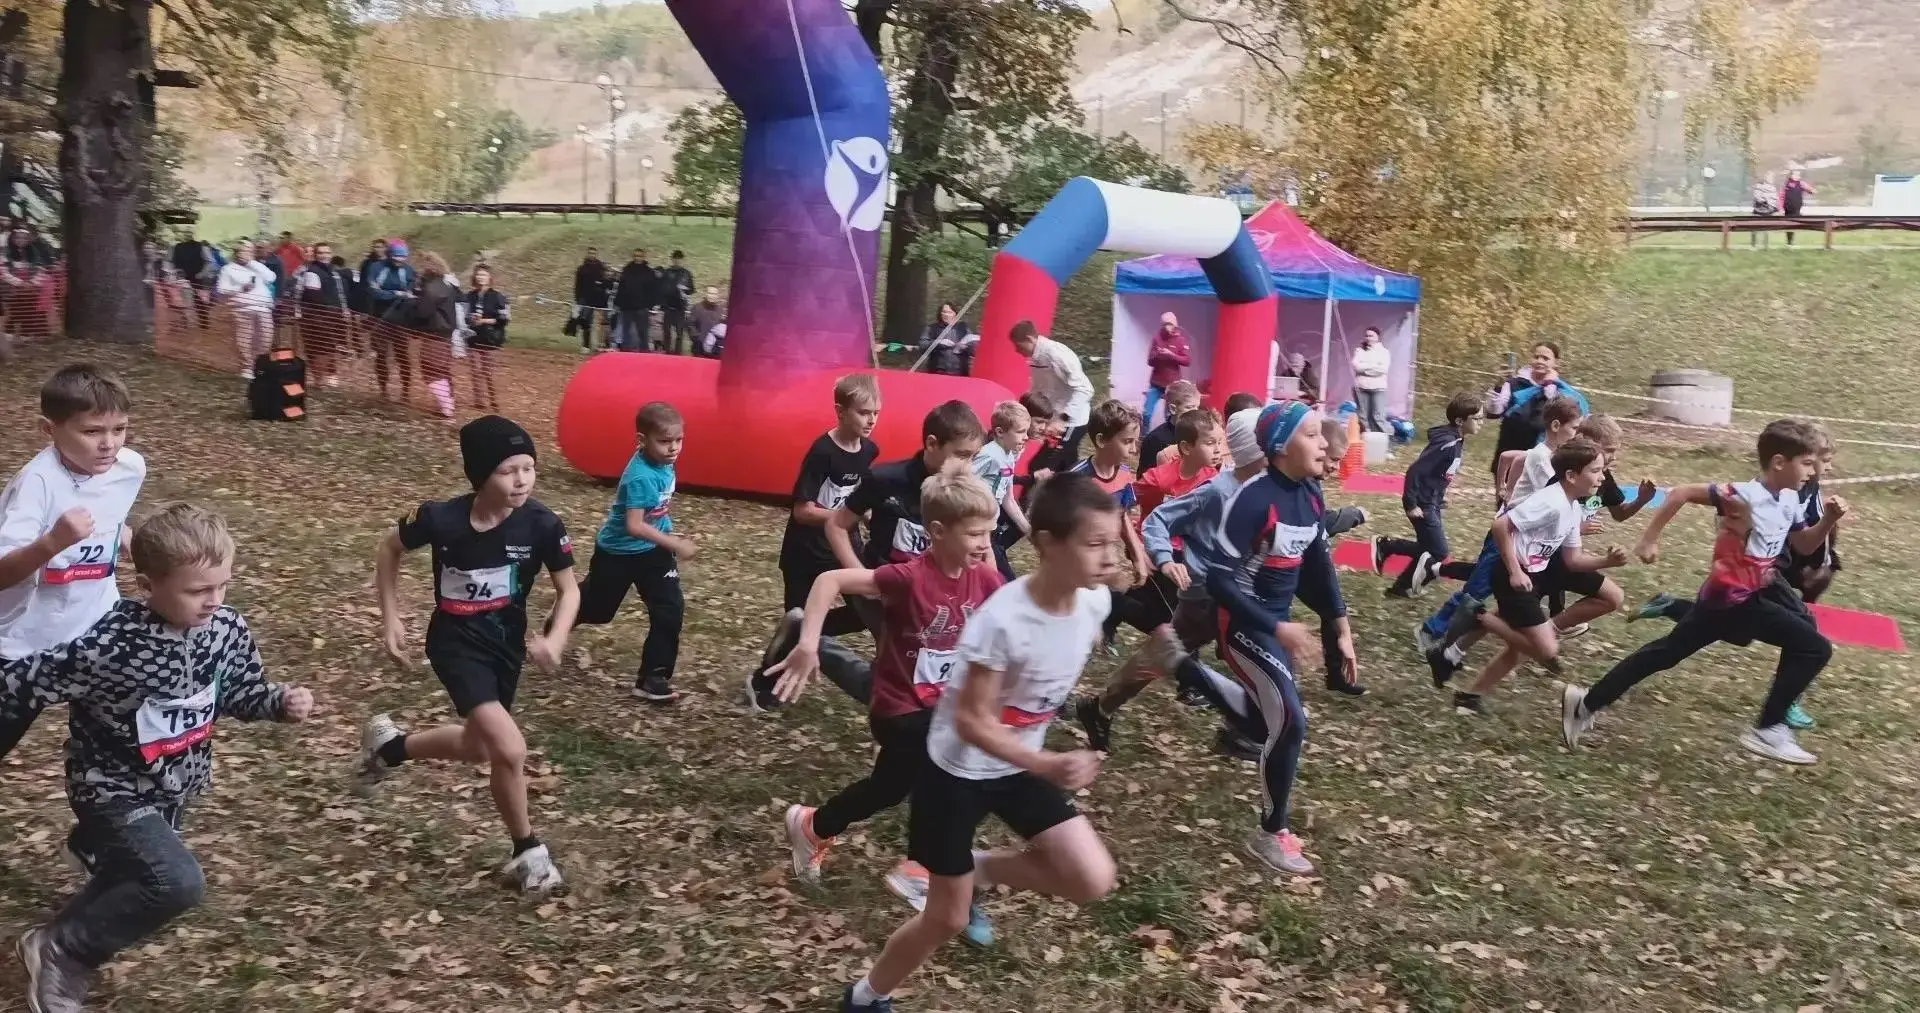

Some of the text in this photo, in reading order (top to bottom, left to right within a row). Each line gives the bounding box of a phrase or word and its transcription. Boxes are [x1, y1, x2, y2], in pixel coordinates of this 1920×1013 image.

[77, 544, 104, 564] 72
[465, 582, 492, 600] 94
[162, 702, 213, 734] 759
